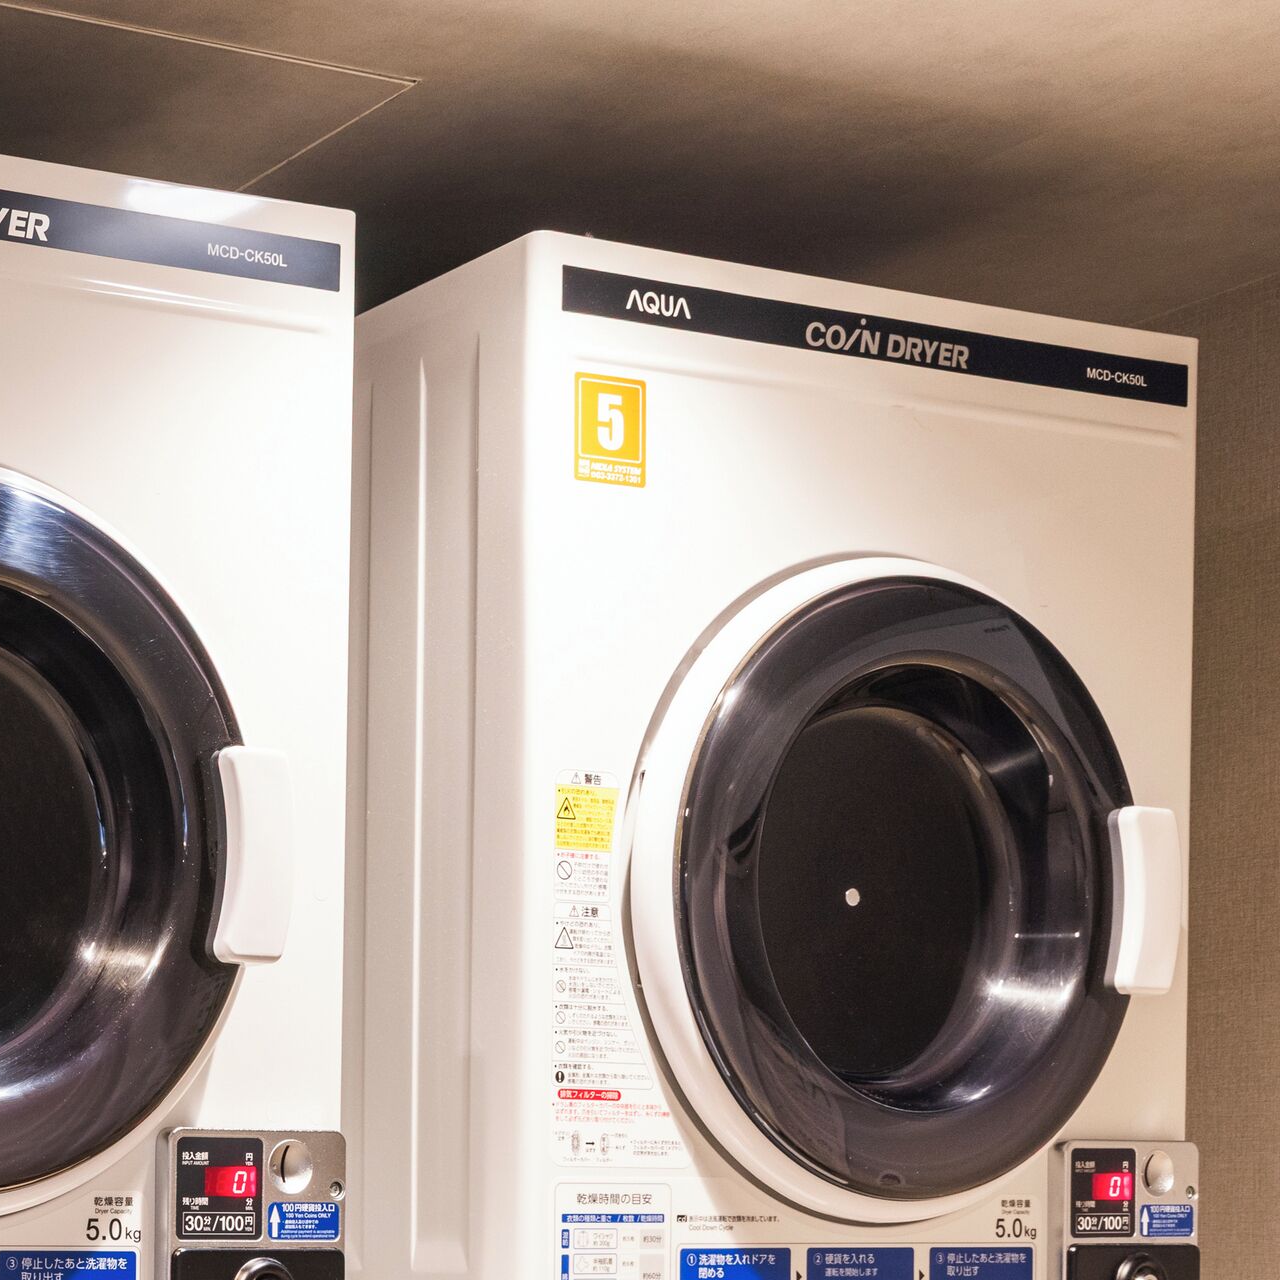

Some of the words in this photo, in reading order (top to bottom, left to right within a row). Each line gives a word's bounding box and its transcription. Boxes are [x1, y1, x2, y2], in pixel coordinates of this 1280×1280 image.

[207, 243, 288, 267] MCD-CK50L
[625, 289, 691, 320] AQUA
[886, 333, 970, 369] DRYER
[1086, 367, 1148, 387] MCD-CK50L
[597, 392, 625, 451] 5
[233, 1171, 248, 1194] 0
[1109, 1176, 1121, 1198] 0
